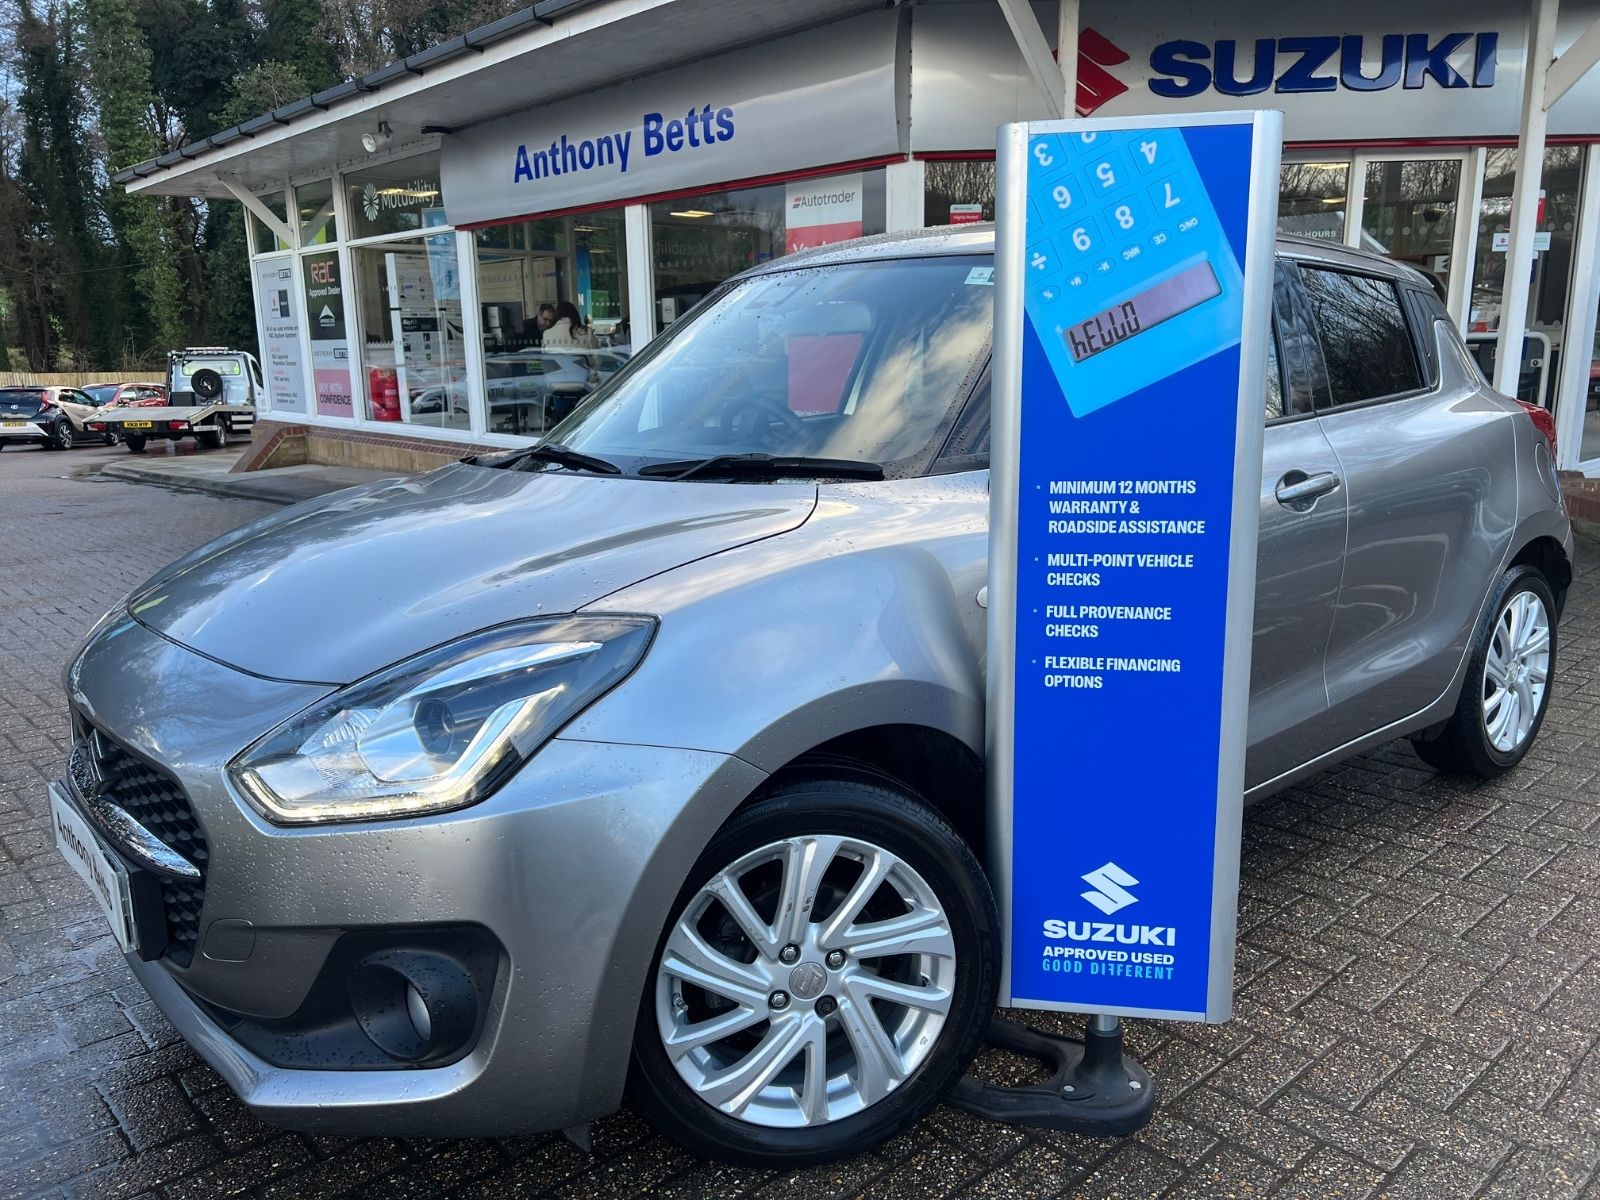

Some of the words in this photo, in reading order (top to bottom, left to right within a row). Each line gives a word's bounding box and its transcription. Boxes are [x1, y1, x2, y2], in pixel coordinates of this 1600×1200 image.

[1148, 32, 1498, 98] SUZUKI
[514, 131, 631, 183] Anthony
[643, 103, 734, 157] Betts
[1034, 143, 1053, 167] 3
[1140, 140, 1158, 164] 4
[1096, 162, 1116, 188] 5
[382, 179, 436, 210] Motability
[801, 191, 855, 208] Autotrader
[1164, 182, 1181, 208] 7
[1115, 205, 1135, 230] 8
[1305, 230, 1337, 238] HOURS
[309, 287, 328, 298] Approved
[320, 394, 352, 406] CONFIDENCE
[1049, 480, 1116, 494] MINIMUM
[1118, 480, 1133, 494] 12
[1135, 480, 1197, 494] MONTHS
[1049, 501, 1127, 514] WARRANTY
[1129, 501, 1140, 514] &
[1048, 520, 1117, 534] ROADSIDE
[1118, 520, 1206, 534] ASSISTANCE
[1047, 553, 1135, 567] MULTI-POINT
[1137, 554, 1194, 568] VEHICLE
[1047, 573, 1101, 586] CHECKS
[1046, 605, 1077, 618] FULL
[1079, 606, 1172, 620] PROVENANCE
[1045, 624, 1099, 638] CHECKS
[1044, 656, 1104, 670] FLEXIBLE
[1106, 657, 1181, 673] FINANCING
[1044, 674, 1103, 689] OPTIONS
[57, 811, 93, 880] Anthony
[1042, 919, 1176, 947] SUZUKI
[1042, 946, 1129, 962] APPROVED
[1130, 952, 1175, 965] USED
[1042, 958, 1083, 974] GOOD
[1090, 962, 1174, 980] DIFFERENT
